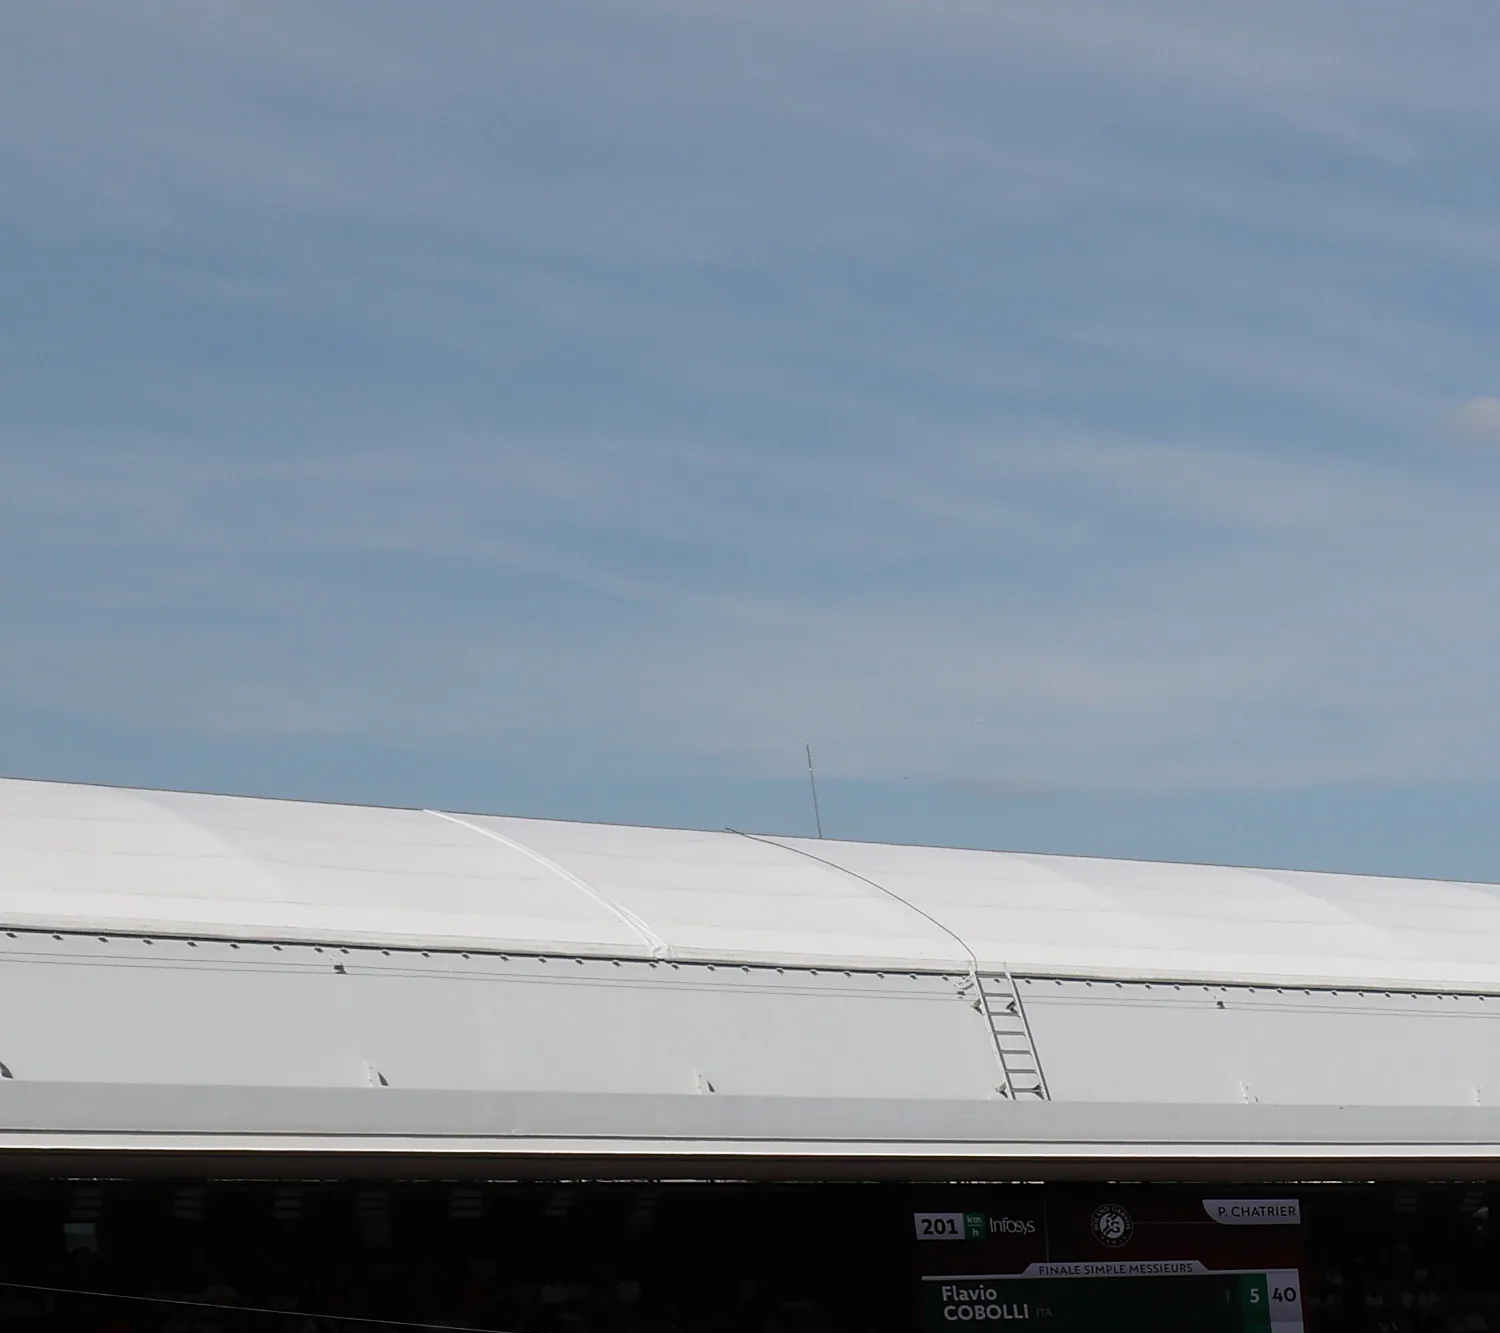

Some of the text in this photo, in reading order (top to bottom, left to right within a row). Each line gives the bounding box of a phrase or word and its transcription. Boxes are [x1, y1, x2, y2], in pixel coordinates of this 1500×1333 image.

[1218, 1205, 1296, 1217] P. CHATRIER
[921, 1219, 959, 1235] 201
[988, 1217, 1036, 1236] Infosys
[1039, 1263, 1193, 1275] FINALE SIMPLE MESSIEURS
[941, 1284, 997, 1302] Flavio
[1249, 1288, 1260, 1304] 5
[1272, 1287, 1297, 1303] 40
[943, 1303, 1053, 1321] COBOLLI ITA
